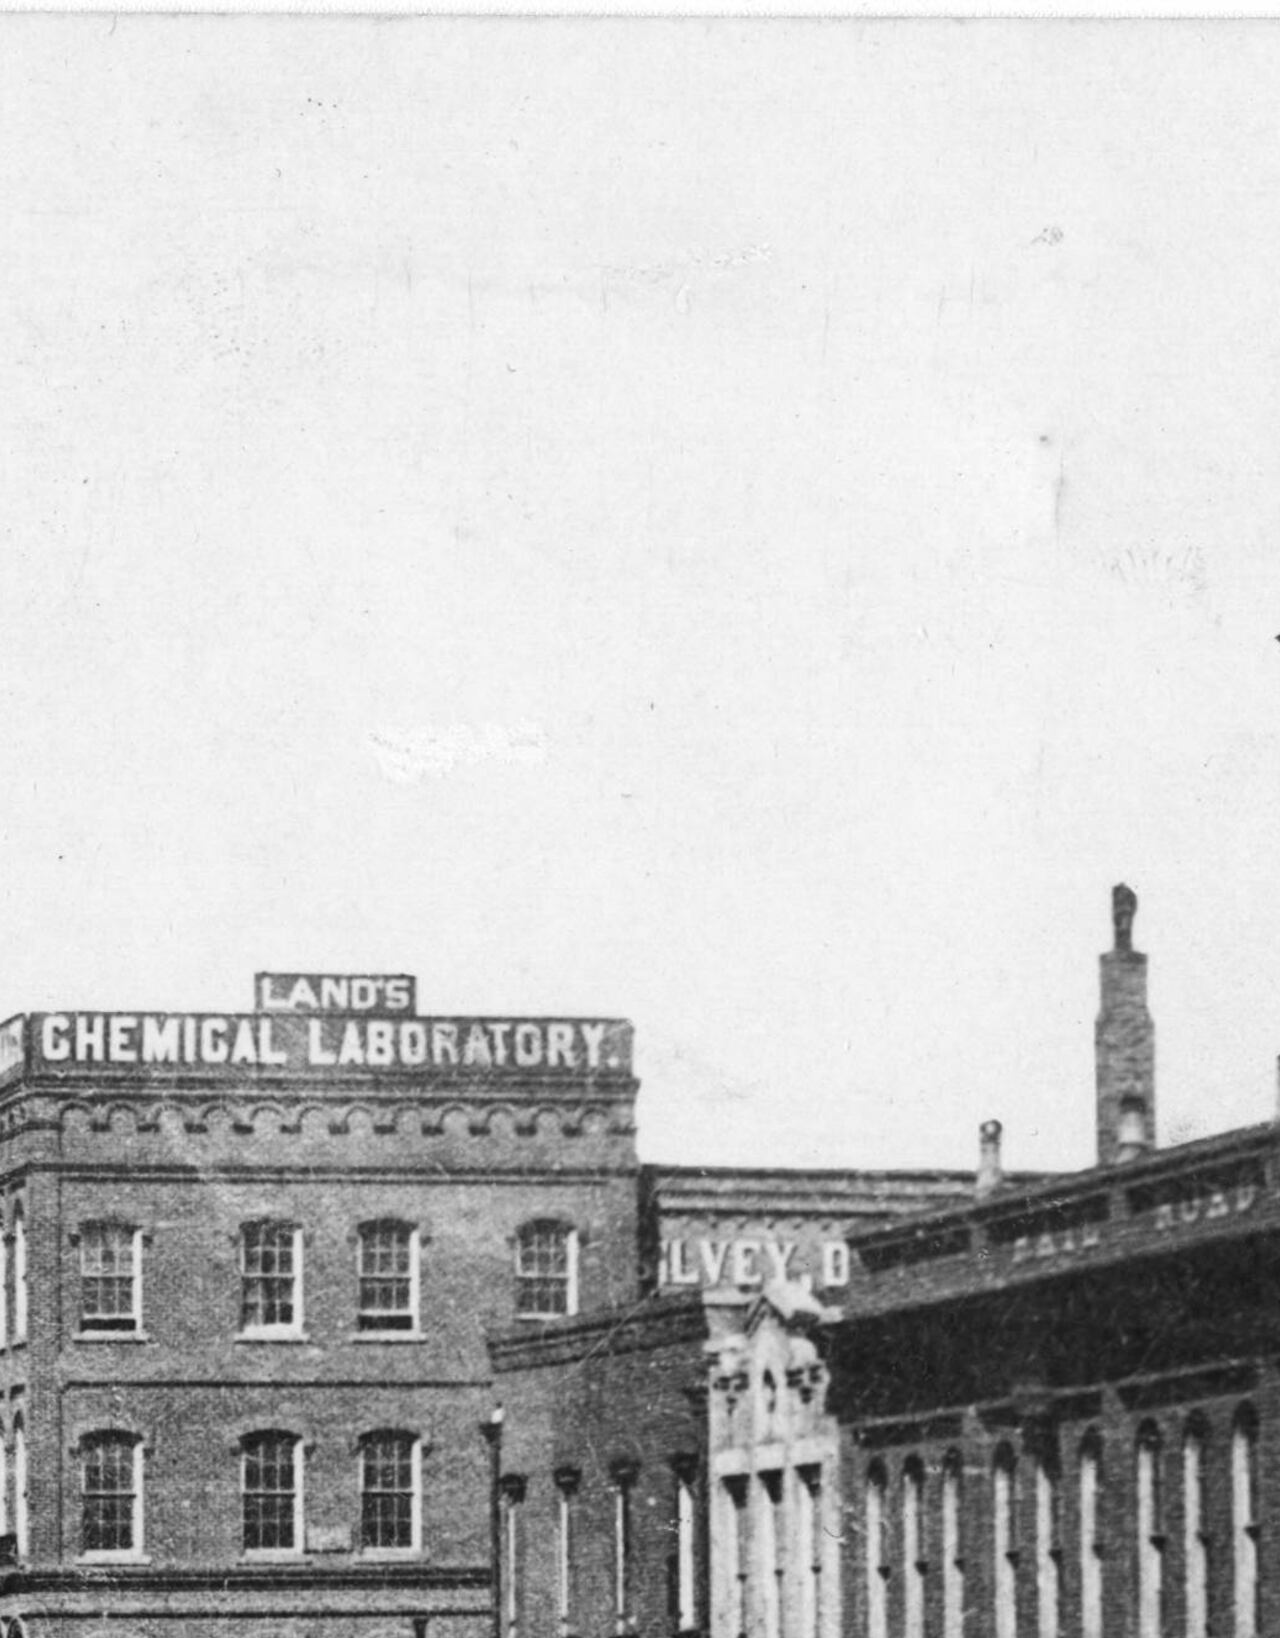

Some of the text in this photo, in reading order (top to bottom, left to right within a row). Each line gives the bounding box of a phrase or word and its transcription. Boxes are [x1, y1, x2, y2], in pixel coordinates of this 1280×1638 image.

[262, 977, 411, 1010] LAND'S
[41, 1014, 288, 1064] CHEMICAL
[308, 1017, 619, 1068] LABORATORY.
